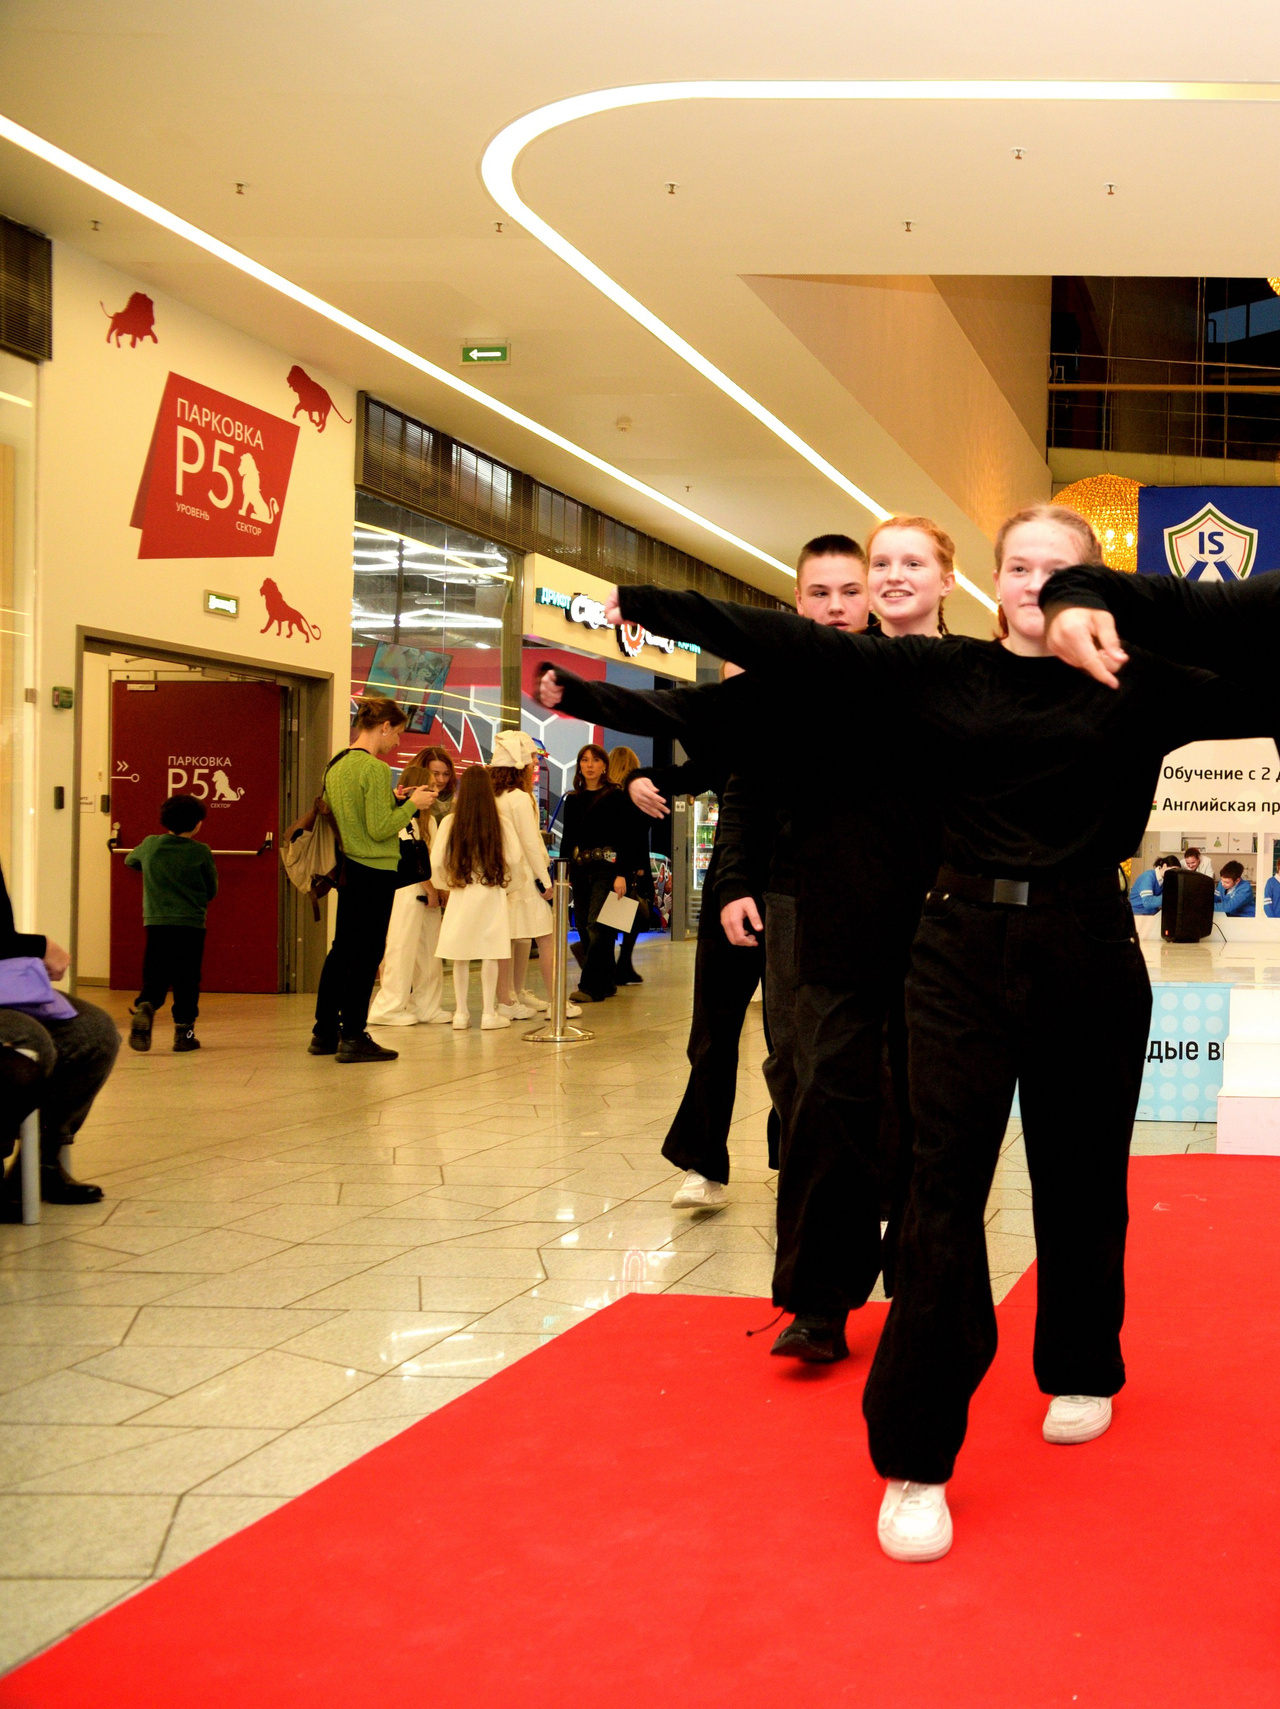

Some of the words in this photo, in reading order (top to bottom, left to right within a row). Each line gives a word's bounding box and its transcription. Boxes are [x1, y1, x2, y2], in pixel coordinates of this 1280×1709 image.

[177, 397, 264, 451] ПАРКОВКА
[176, 425, 235, 509] P5
[176, 502, 210, 521] УРОВЕНЬ
[235, 521, 262, 536] СЕКТОР
[1198, 531, 1225, 555] IS
[167, 756, 232, 767] ПАРКОВКА
[167, 768, 209, 800] P5
[1163, 766, 1243, 782] Обучение
[1248, 769, 1256, 780] с
[1261, 767, 1271, 780] 2
[1162, 797, 1256, 812] Английская
[1145, 1040, 1199, 1063] дые
[1208, 1041, 1224, 1061] в
